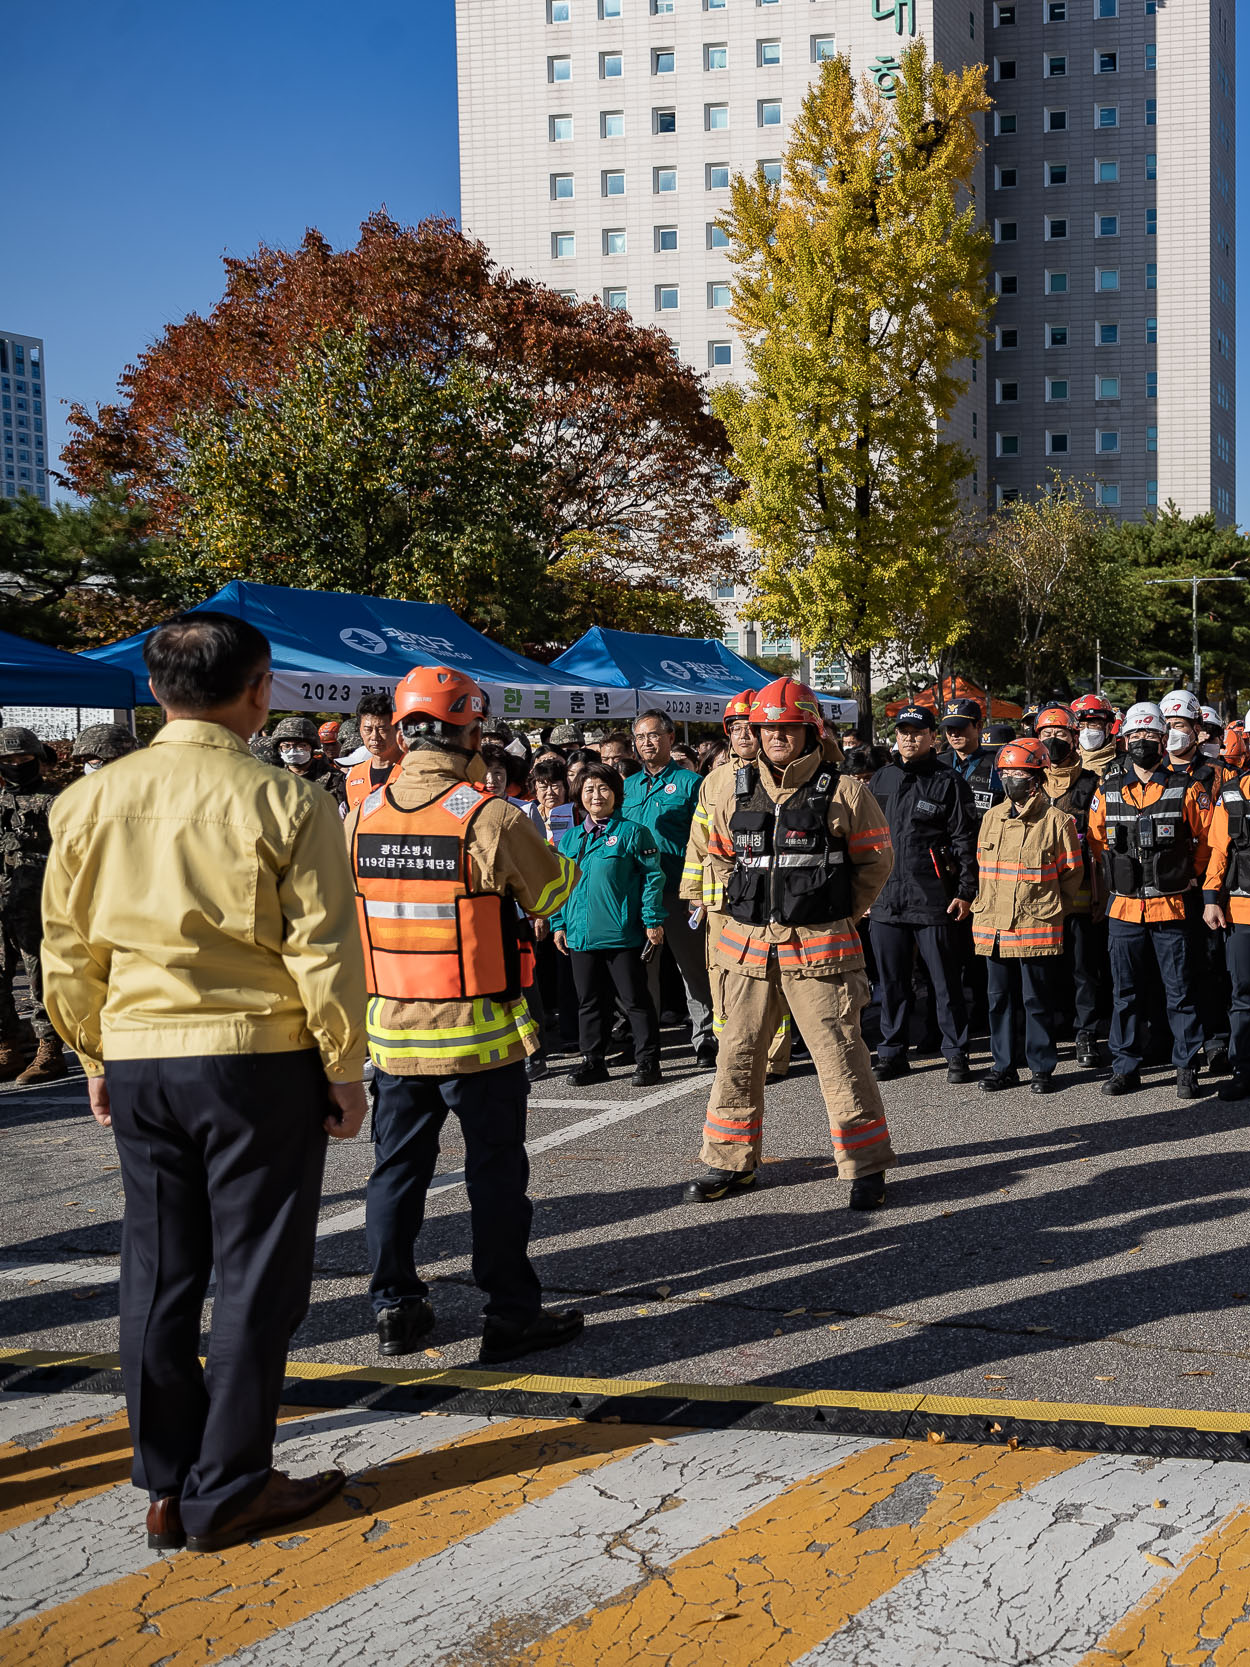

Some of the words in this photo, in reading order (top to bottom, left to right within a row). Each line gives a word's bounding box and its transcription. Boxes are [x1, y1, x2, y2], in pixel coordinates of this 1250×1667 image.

[381, 628, 455, 651] 광진구
[682, 661, 730, 675] 광진구
[302, 683, 351, 701] 2023
[666, 700, 691, 713] 2023
[695, 701, 720, 715] 광진구
[380, 844, 432, 857] 광진소방서
[359, 857, 456, 870] 119긴급구조통제단장
